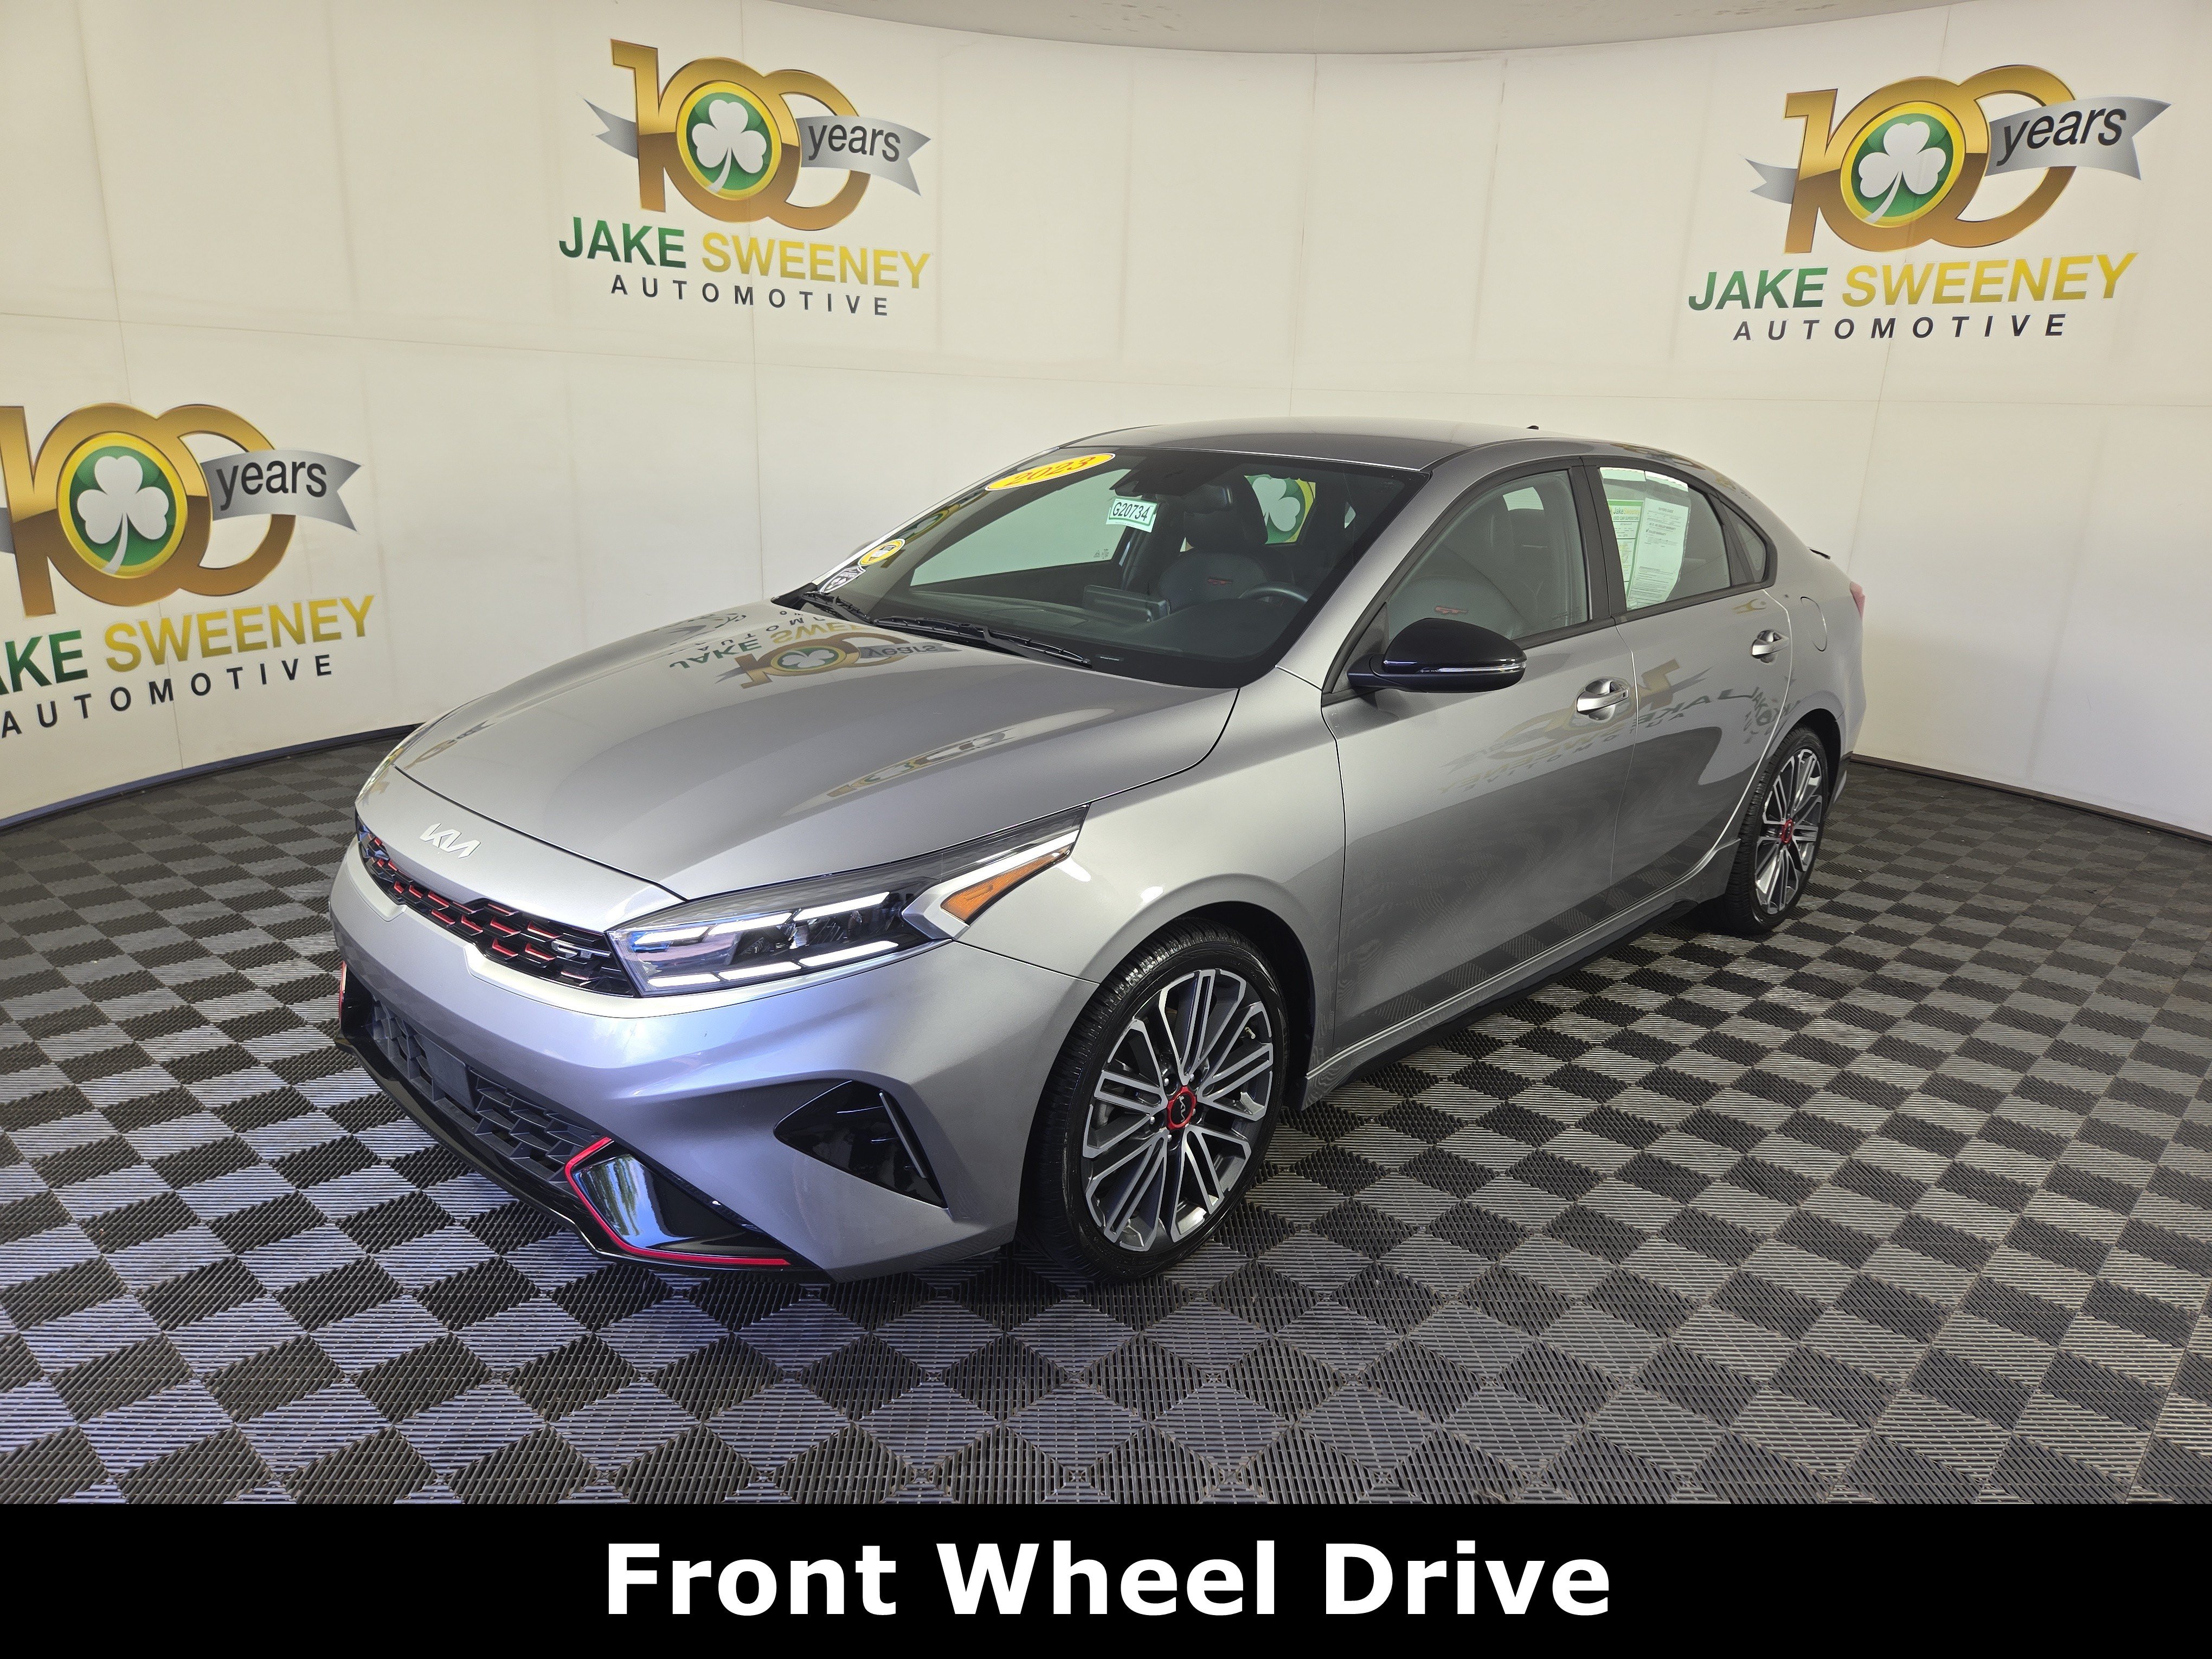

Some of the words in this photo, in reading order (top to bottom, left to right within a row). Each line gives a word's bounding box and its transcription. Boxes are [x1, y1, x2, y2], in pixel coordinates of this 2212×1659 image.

[611, 38, 871, 231] 100
[807, 123, 901, 162] years
[1784, 64, 2077, 254] 100
[1997, 106, 2126, 168] years
[559, 216, 687, 269] JAKE
[702, 232, 931, 289] SWEENEY
[1688, 266, 1828, 311] JAKE
[1842, 252, 2138, 308] SWEENEY
[611, 274, 888, 316] AUTOMOTIVE
[1733, 313, 2066, 342] AUTOMOTIVE
[216, 460, 327, 512] years
[1004, 456, 1096, 487] 2023
[0, 402, 295, 619] 100
[1113, 501, 1150, 522] G20734
[0, 629, 88, 696] KE
[104, 595, 375, 673] SWEENEY
[2, 654, 332, 738] AUTOMOTIVE
[420, 823, 481, 859] KIA
